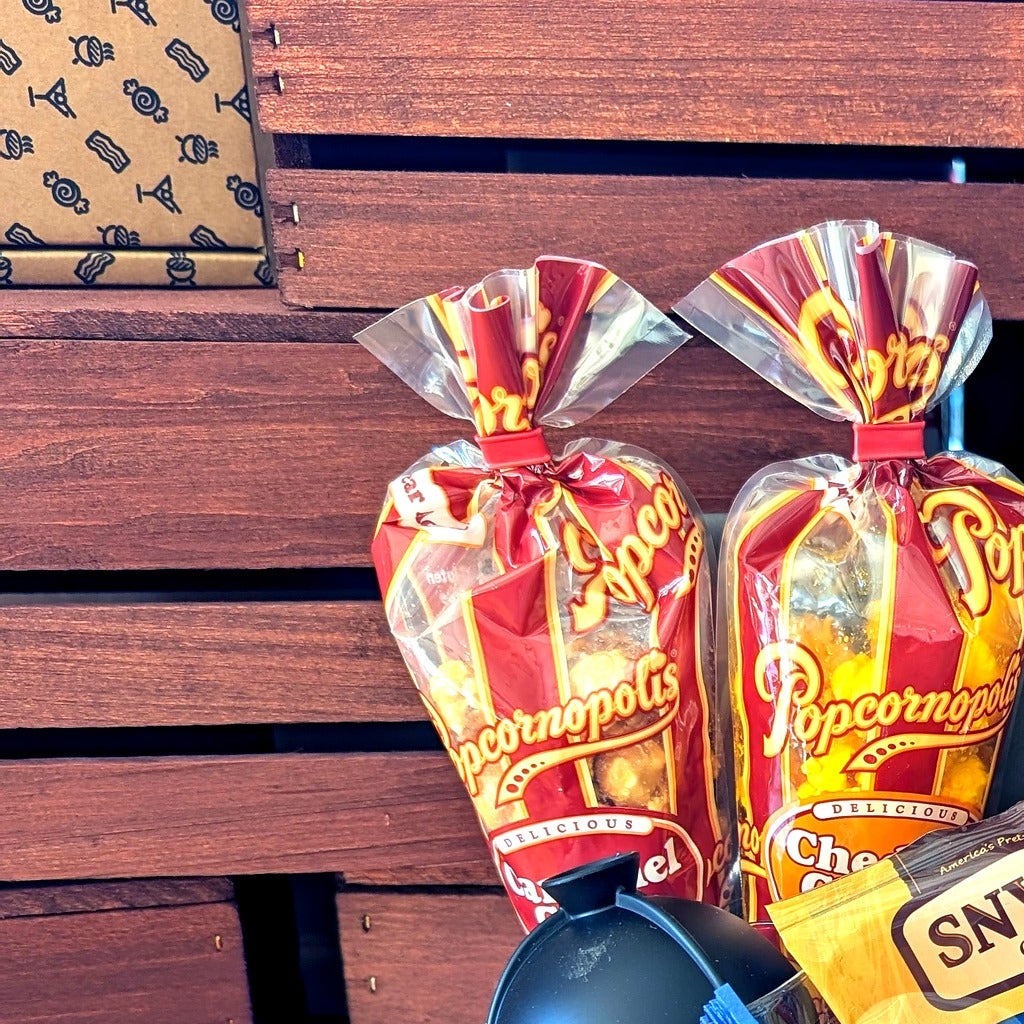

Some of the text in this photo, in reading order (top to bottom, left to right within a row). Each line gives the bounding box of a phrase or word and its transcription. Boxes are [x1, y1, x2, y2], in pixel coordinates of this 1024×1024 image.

[446, 646, 679, 796] pcornopolis
[832, 802, 958, 821] DELICIOUS
[503, 818, 633, 848] DELICIOUS
[939, 843, 995, 876] America's
